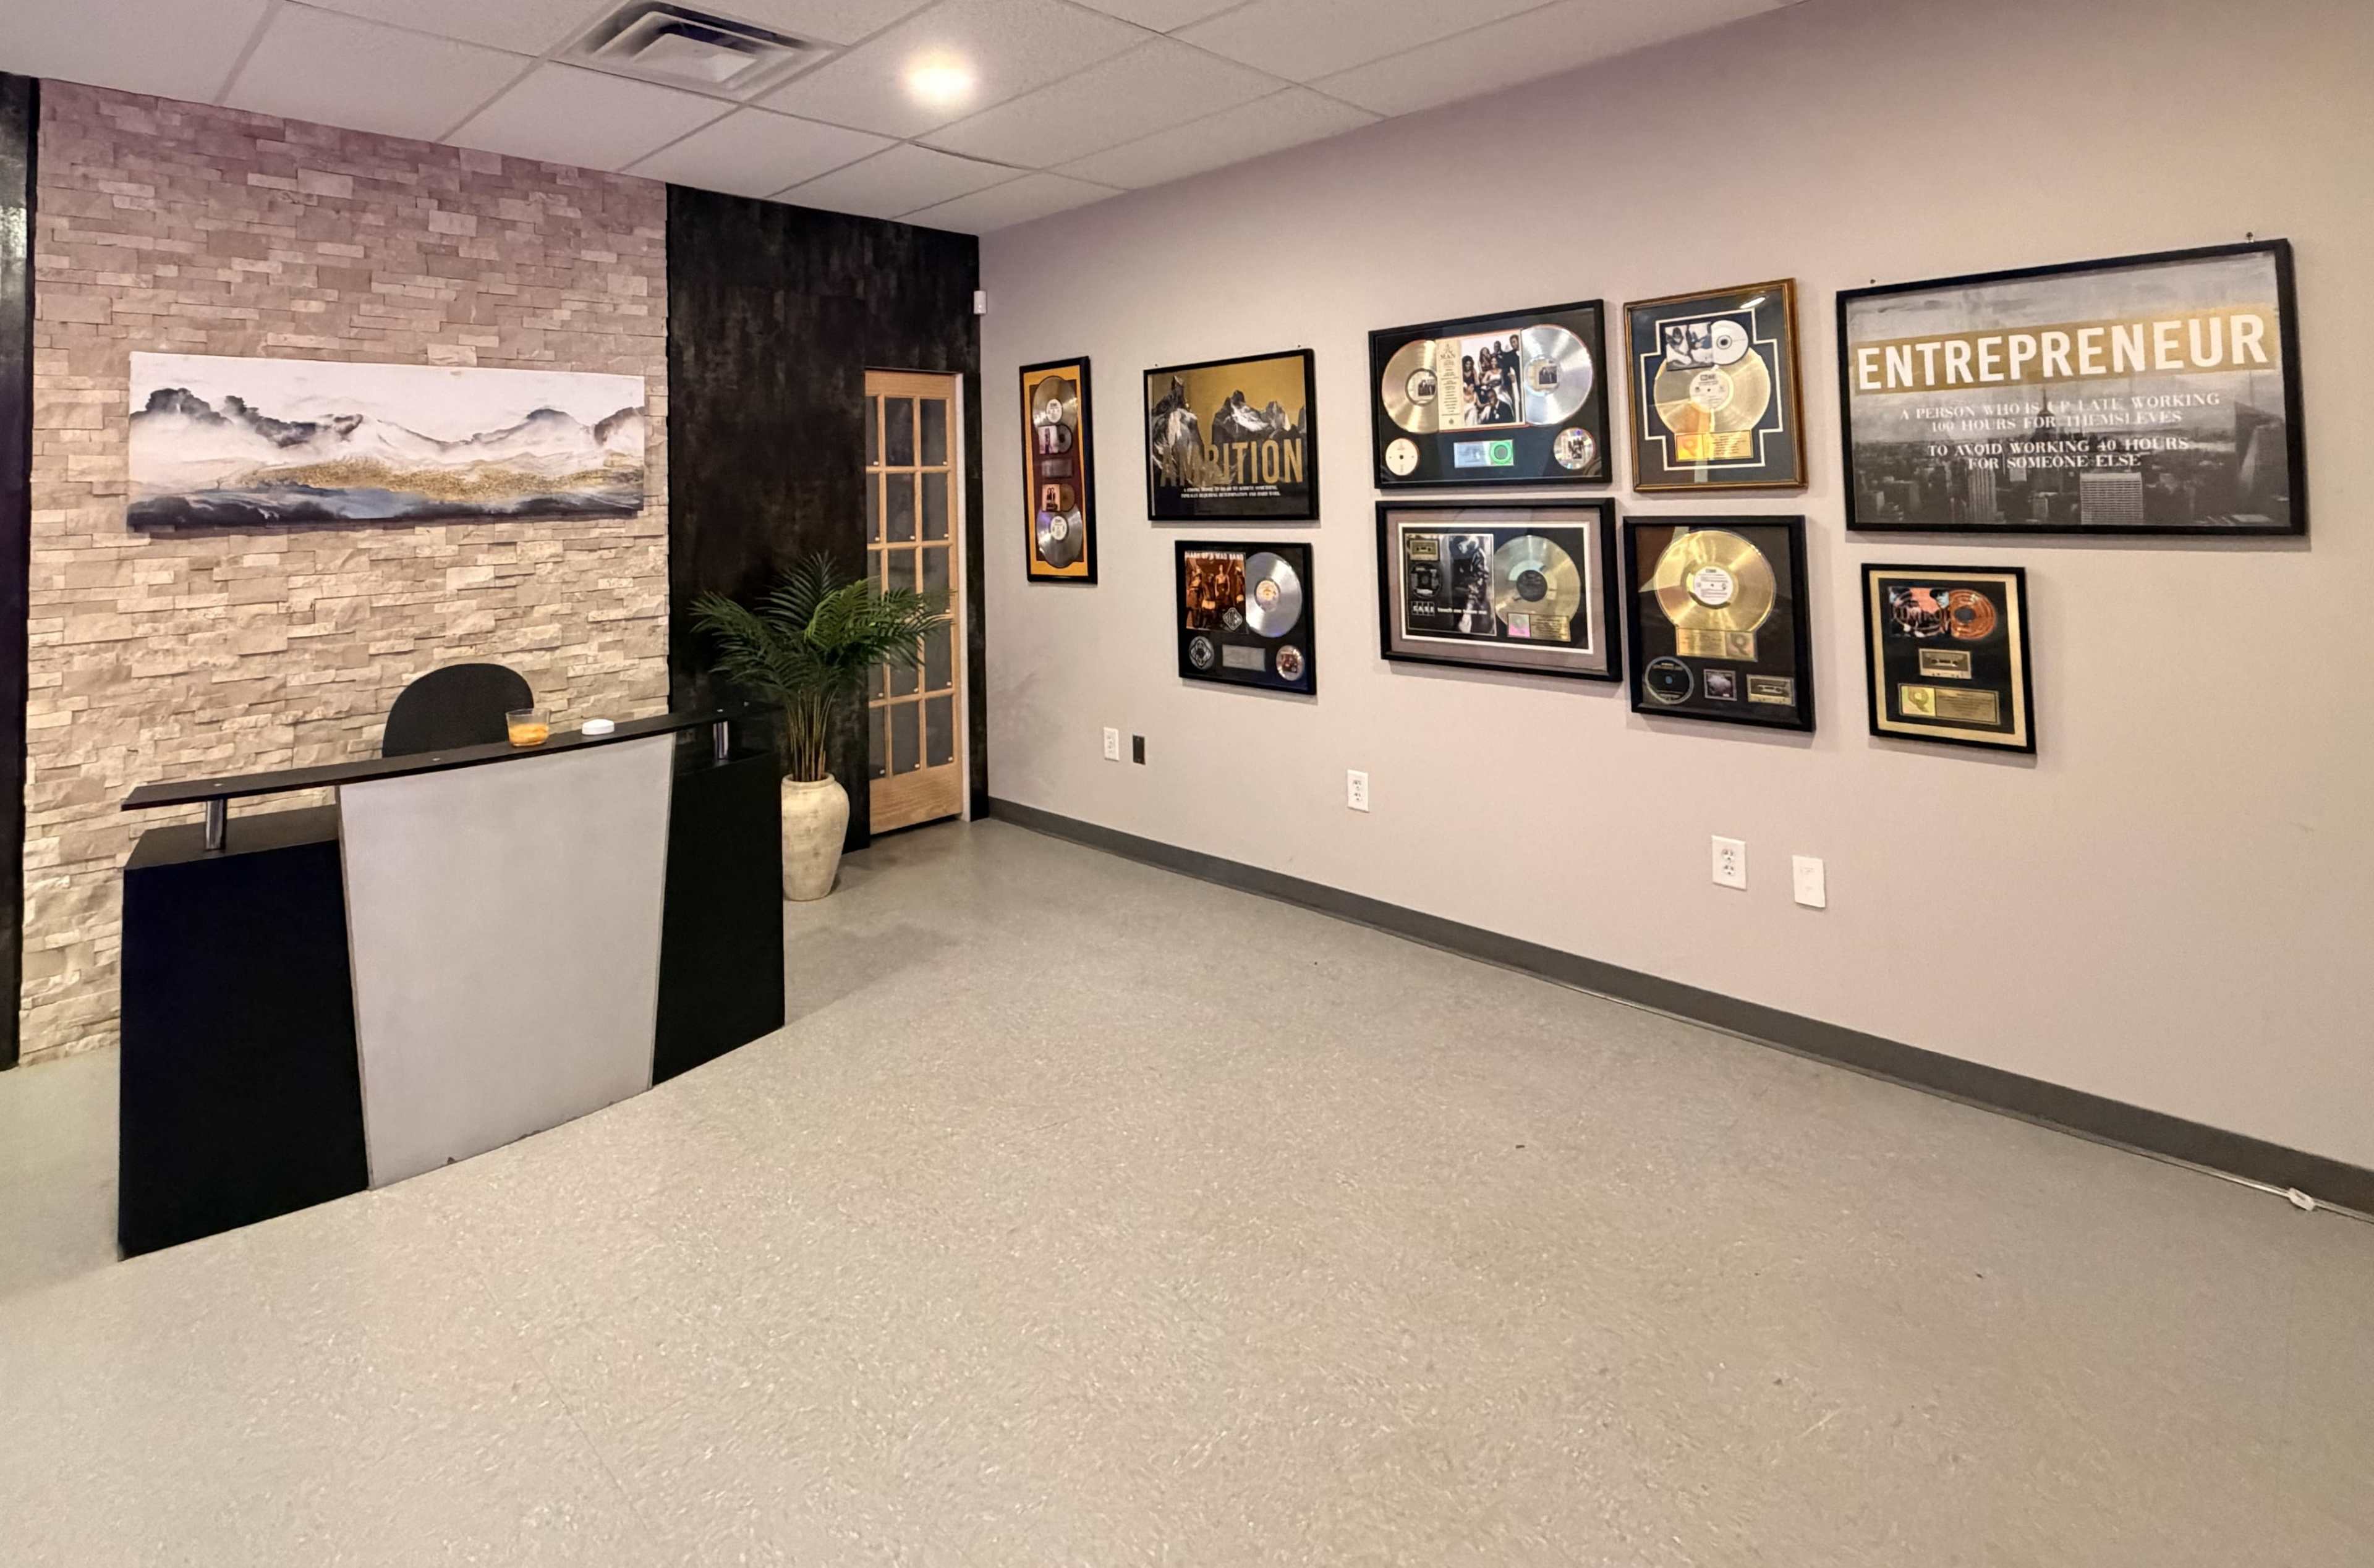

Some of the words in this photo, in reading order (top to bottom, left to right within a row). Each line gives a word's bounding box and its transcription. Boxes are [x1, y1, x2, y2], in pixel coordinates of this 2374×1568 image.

[1857, 314, 2269, 390] ENTREPRENEUR
[1899, 409, 1910, 421] A
[1916, 406, 1975, 419] PERSON
[1983, 402, 2020, 416] WHO
[2024, 402, 2040, 414] IS
[2130, 392, 2221, 409] WORKING
[1932, 421, 1955, 432] 100
[1961, 417, 2017, 431] HOURS
[2023, 415, 2057, 429] FOR
[1928, 444, 1949, 457] TO
[1954, 443, 2004, 457] AVOID
[2009, 439, 2090, 454] WORKING
[2096, 439, 2117, 452] 40
[2124, 436, 2190, 452] HOURS
[1160, 438, 1304, 488] AMBITION
[1967, 457, 2000, 470] FOR
[2007, 454, 2090, 469] SOMEONE
[2096, 452, 2143, 467] ELSE
